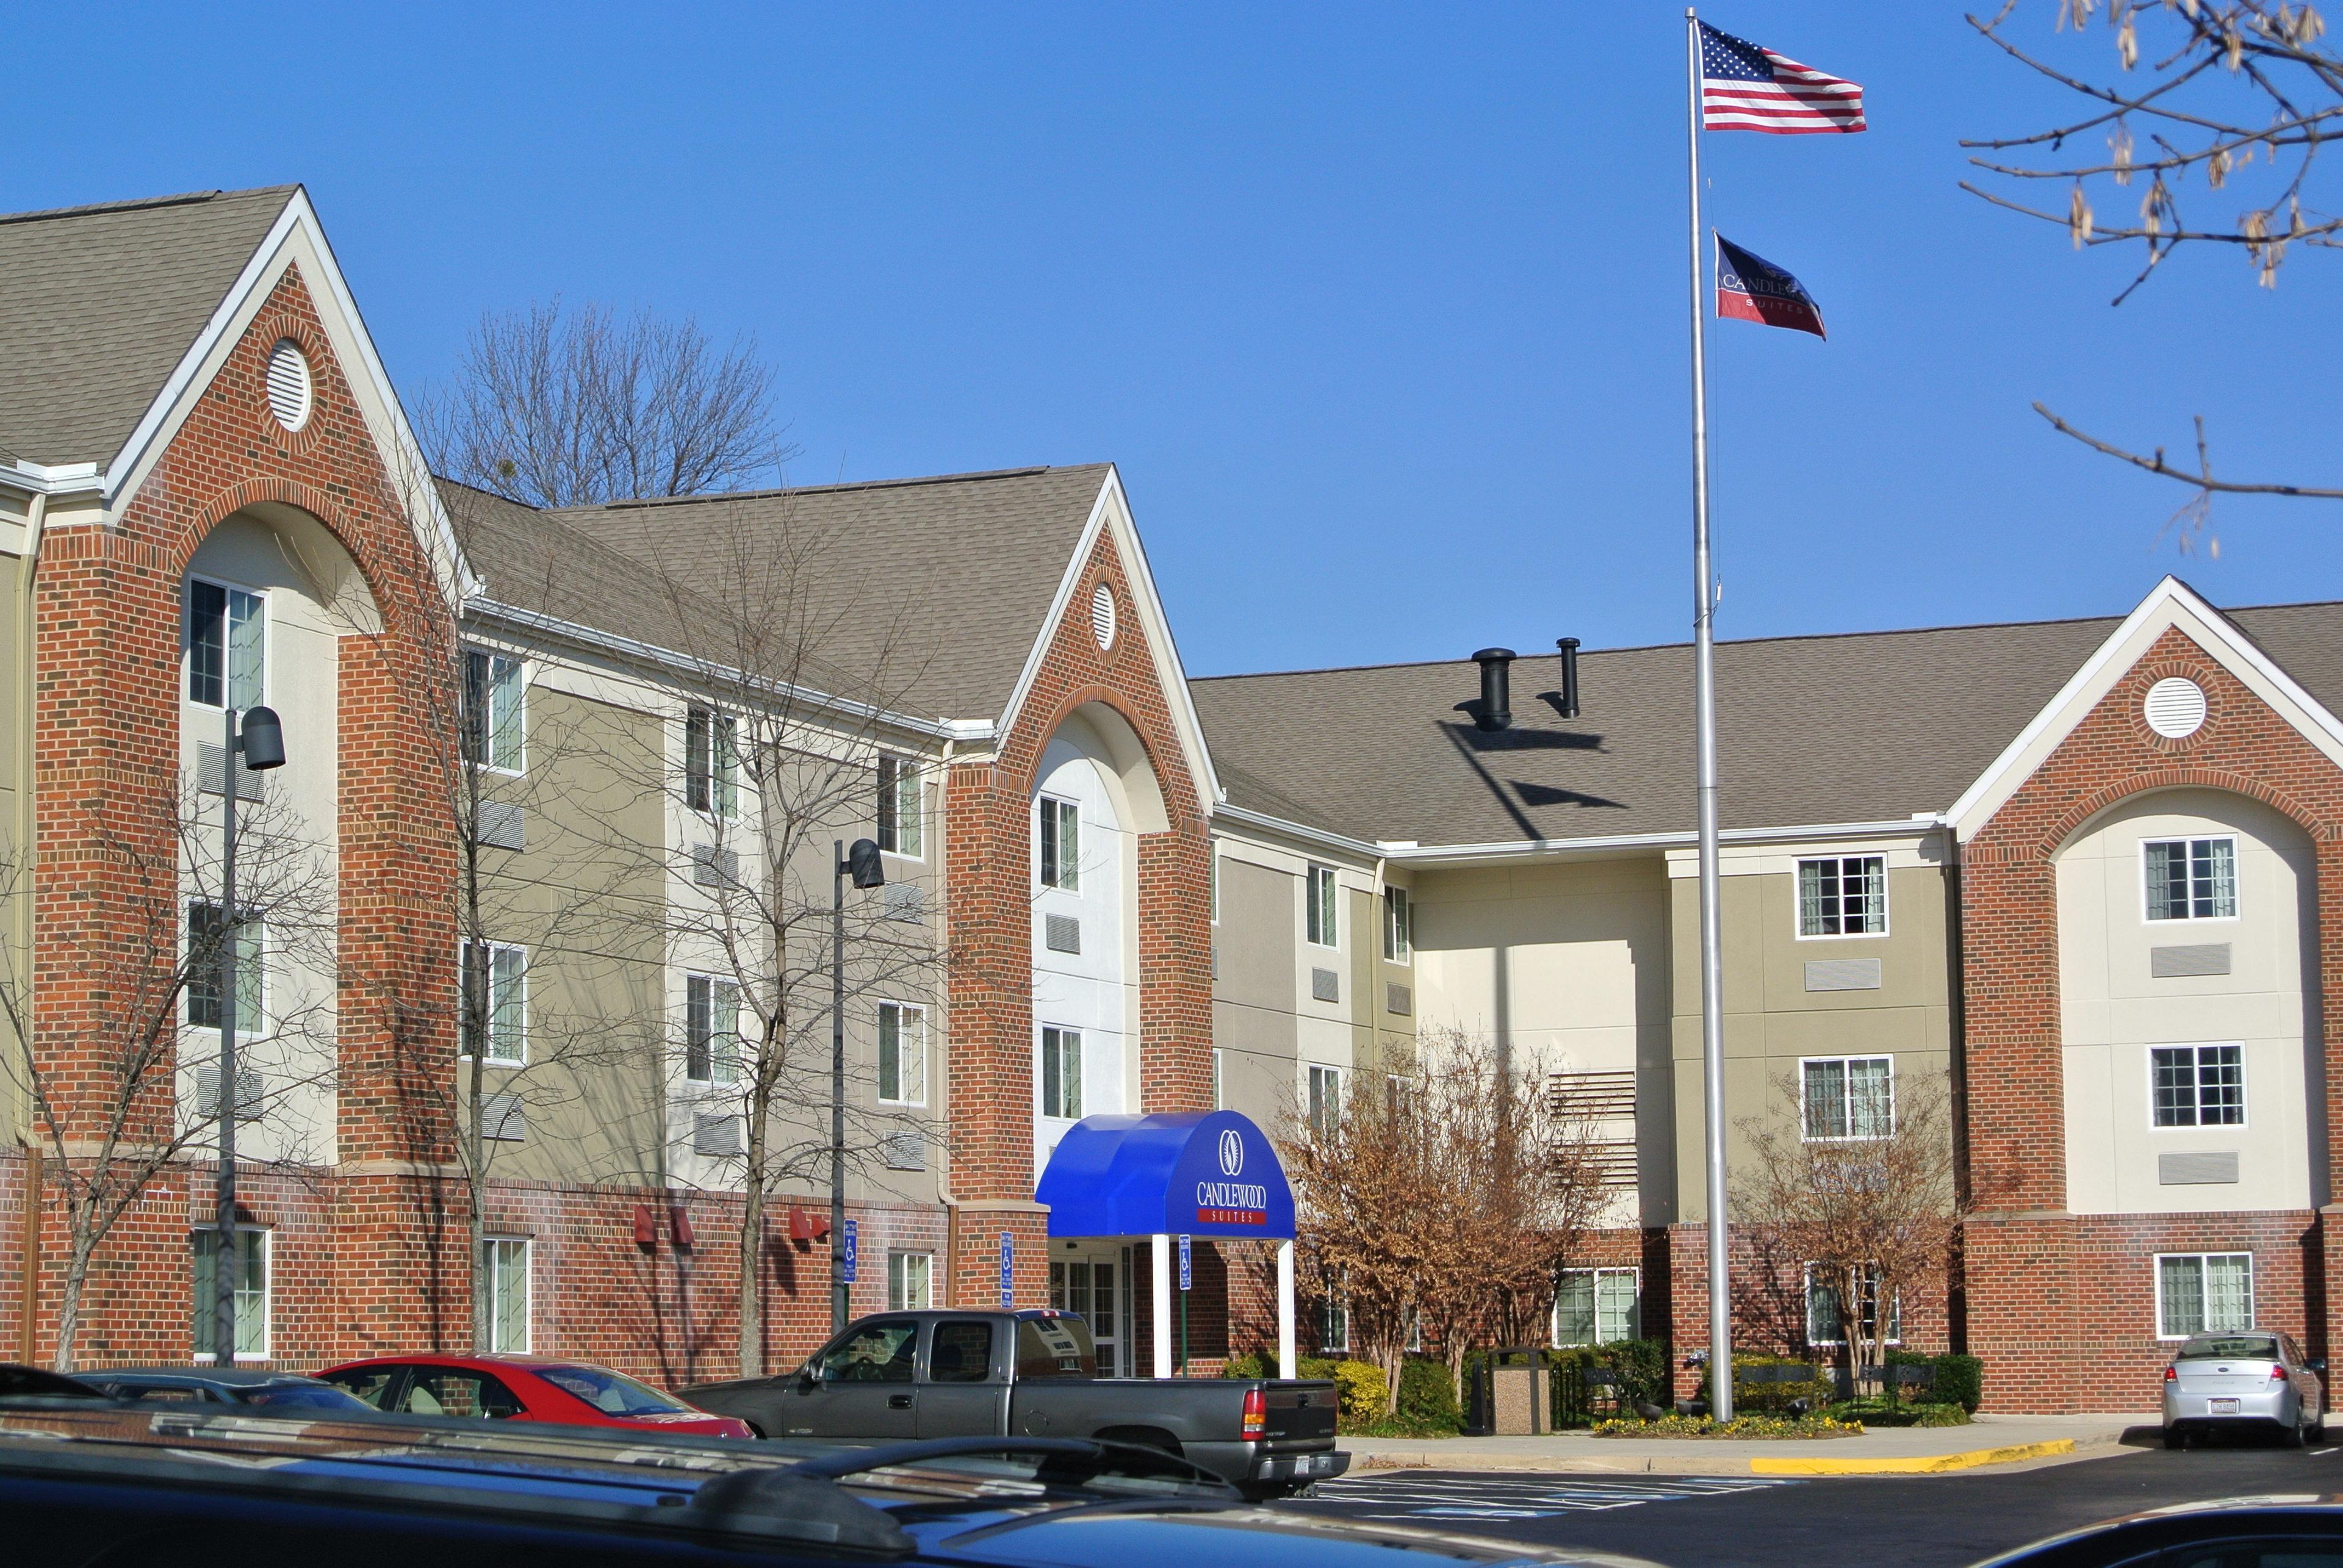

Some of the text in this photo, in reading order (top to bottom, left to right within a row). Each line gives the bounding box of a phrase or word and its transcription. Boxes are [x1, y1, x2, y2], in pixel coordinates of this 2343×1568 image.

[1723, 274, 1806, 302] CANDLEWO
[1746, 298, 1802, 314] SUITES
[1197, 1181, 1267, 1209] CANDLEWOOD
[1212, 1210, 1252, 1223] SUITES
